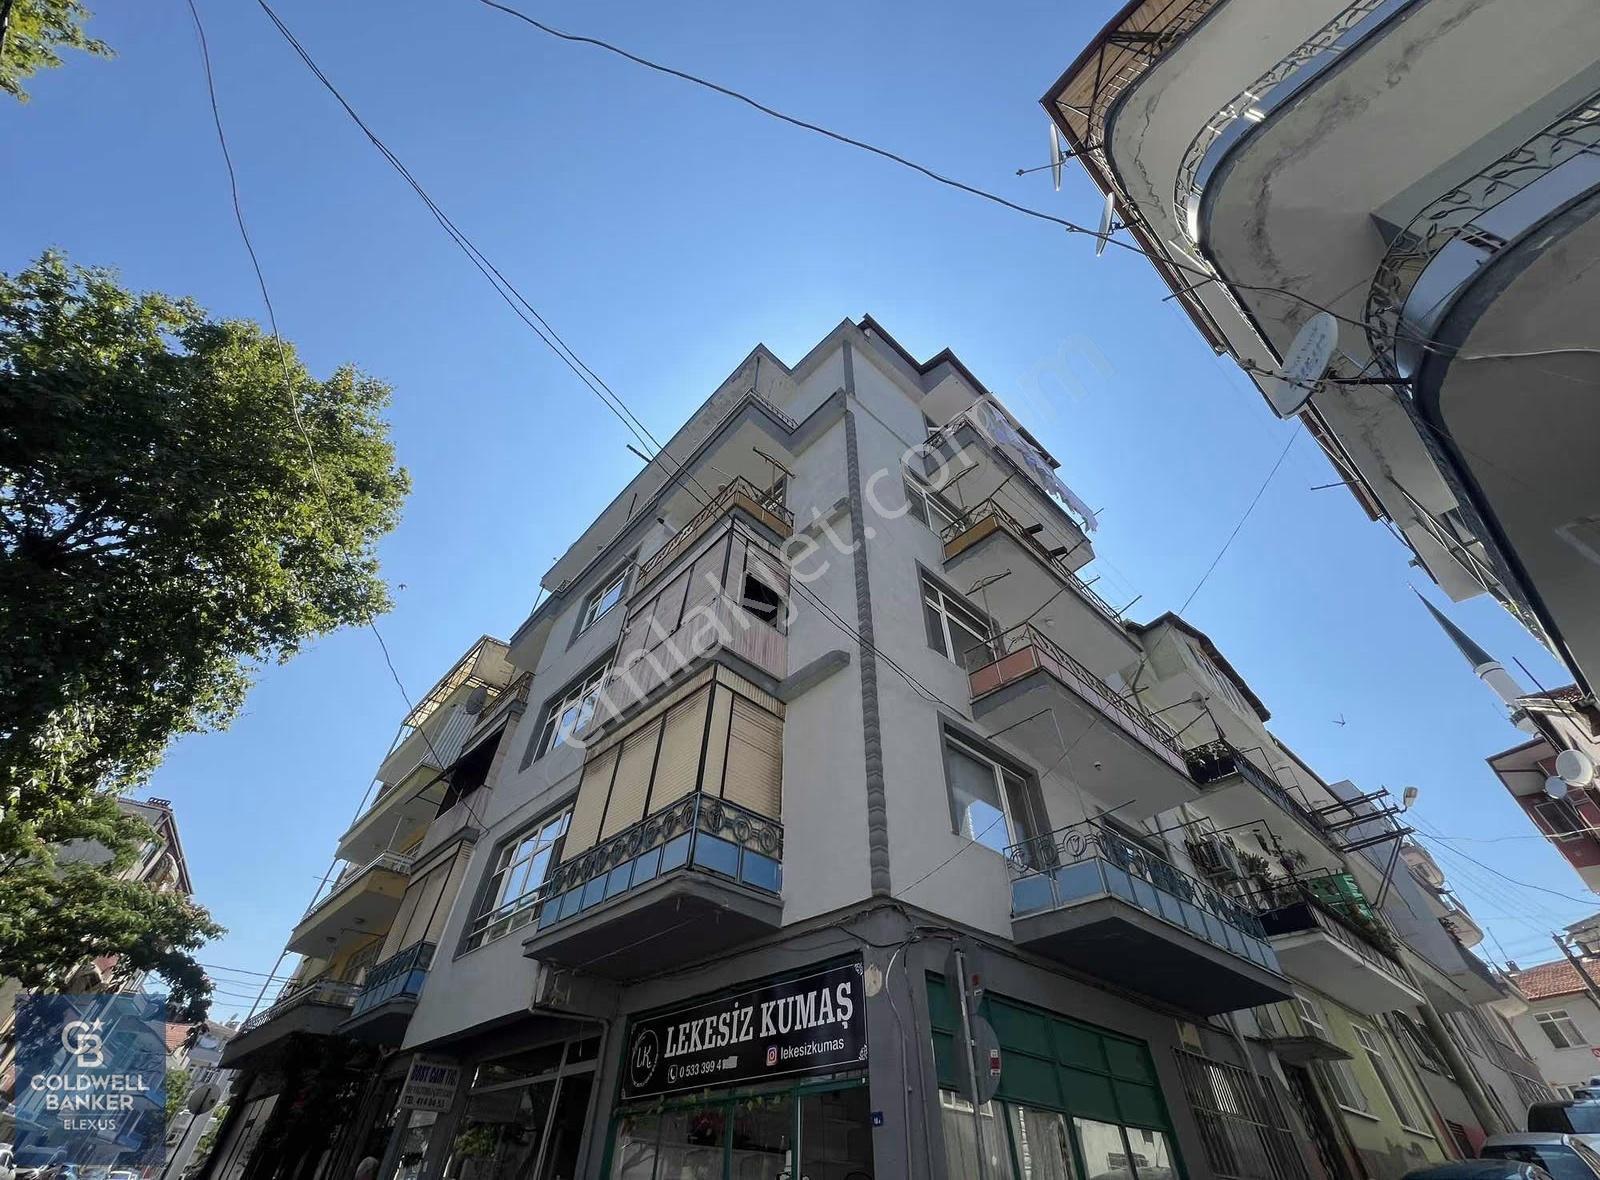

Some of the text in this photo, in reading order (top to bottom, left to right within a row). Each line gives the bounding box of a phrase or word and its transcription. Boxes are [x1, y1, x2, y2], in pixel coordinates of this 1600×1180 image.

[664, 981, 853, 1058] LEKESİZ KUMAŞ
[780, 1038, 845, 1060] lekesizkumas
[679, 1066, 685, 1078] 0
[686, 1063, 699, 1077] 533
[701, 1060, 715, 1074] 399
